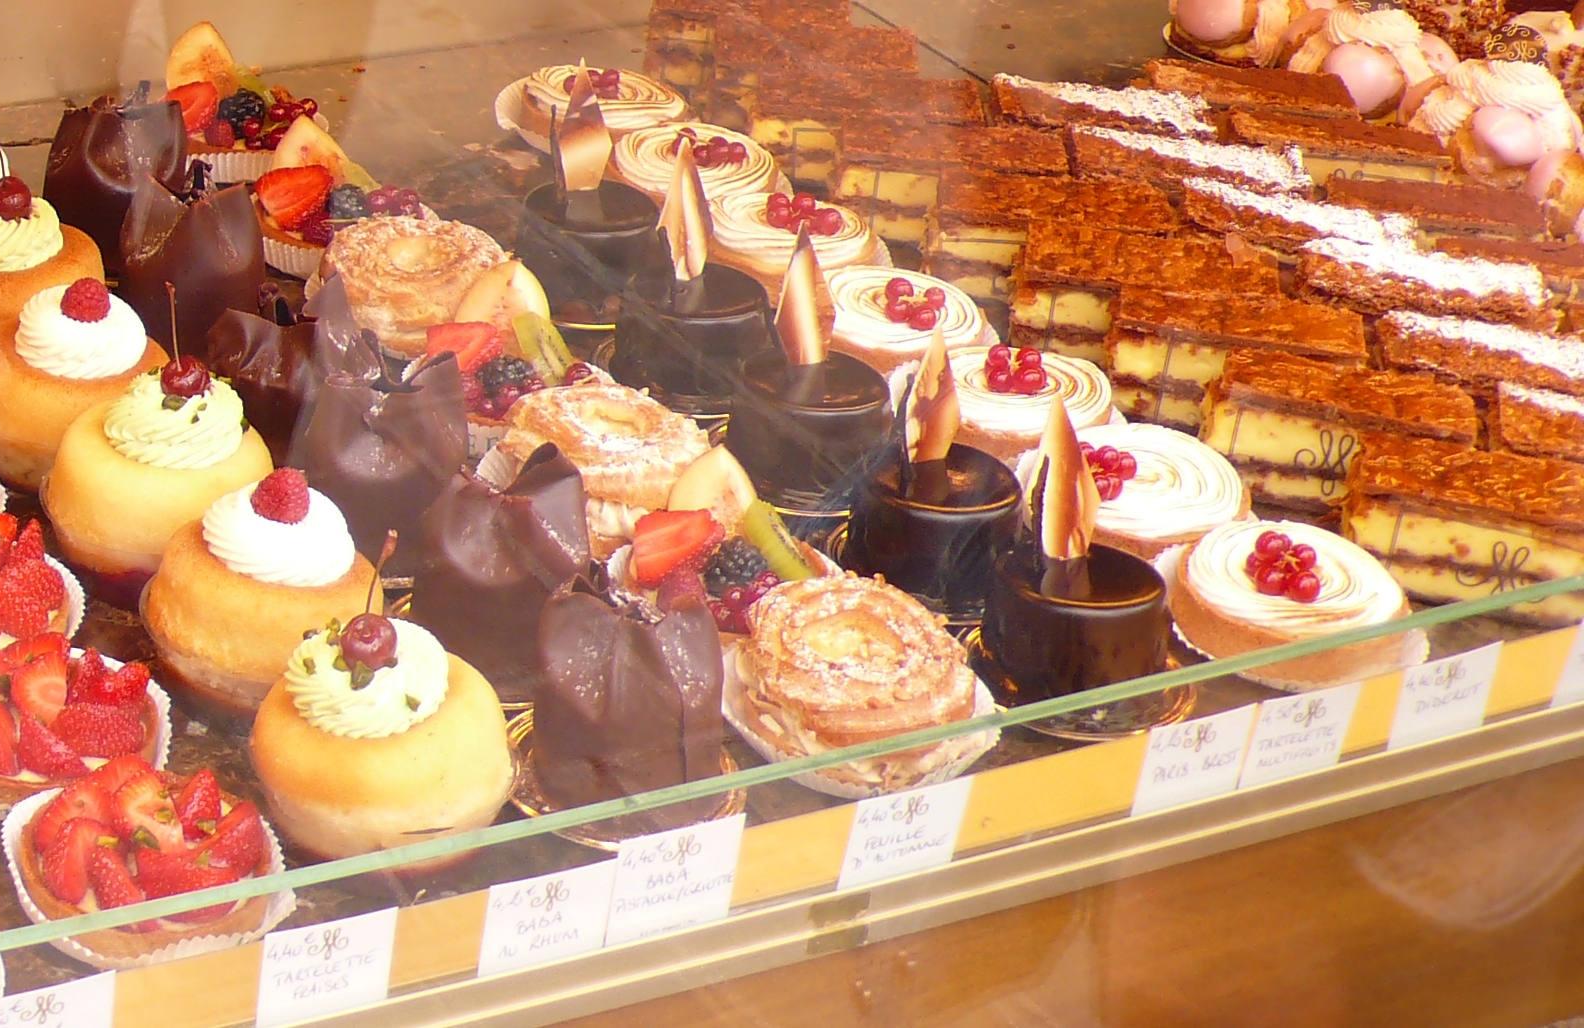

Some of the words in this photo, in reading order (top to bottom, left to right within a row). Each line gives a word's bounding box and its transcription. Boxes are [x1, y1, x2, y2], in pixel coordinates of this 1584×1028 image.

[1258, 722, 1340, 751] TARTELETTE
[864, 824, 927, 850] FEUILLE
[646, 867, 689, 889] BABA
[517, 911, 562, 935] BABA
[498, 944, 518, 959] AU
[529, 928, 579, 952] RHUM
[273, 948, 378, 987] TARTELETTE
